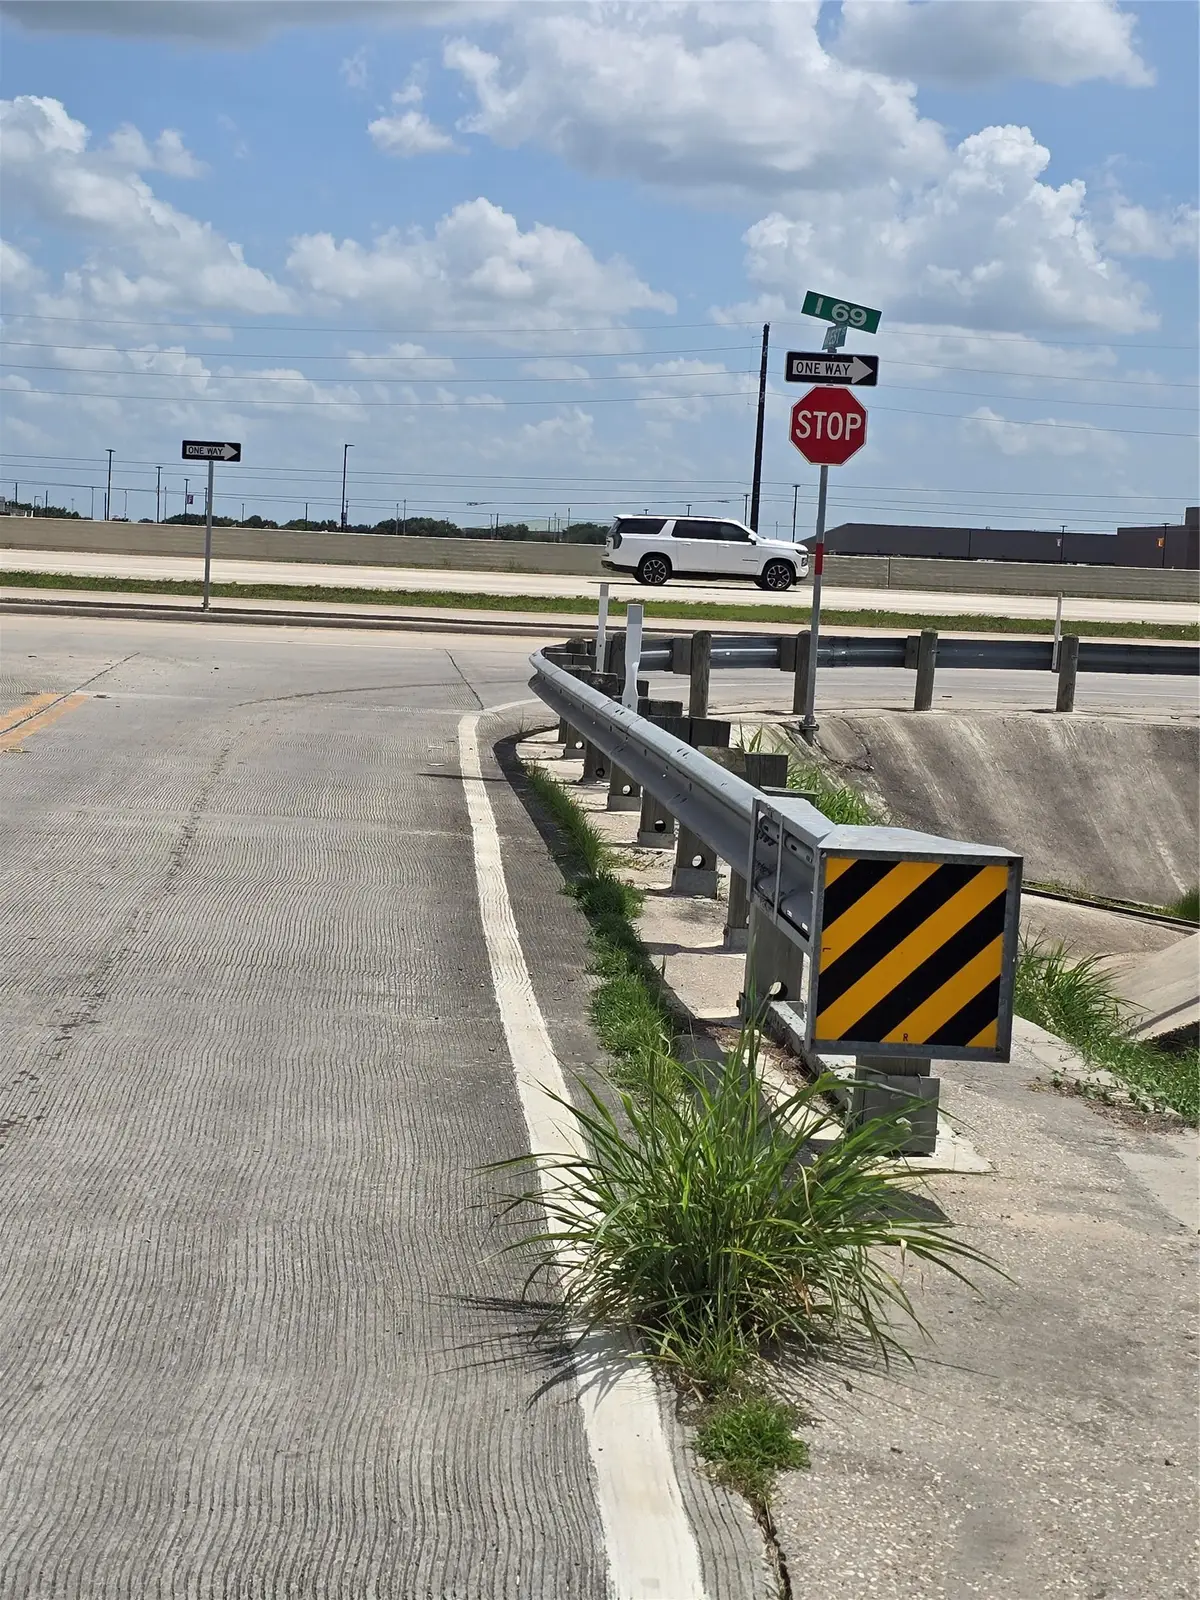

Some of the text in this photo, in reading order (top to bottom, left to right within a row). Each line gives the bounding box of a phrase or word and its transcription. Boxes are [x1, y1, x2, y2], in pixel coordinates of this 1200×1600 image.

[814, 297, 868, 327] I 69
[796, 361, 851, 376] ONE WAY
[795, 410, 862, 441] STOP
[188, 446, 223, 455] ONE WAY
[902, 1032, 909, 1042] R
